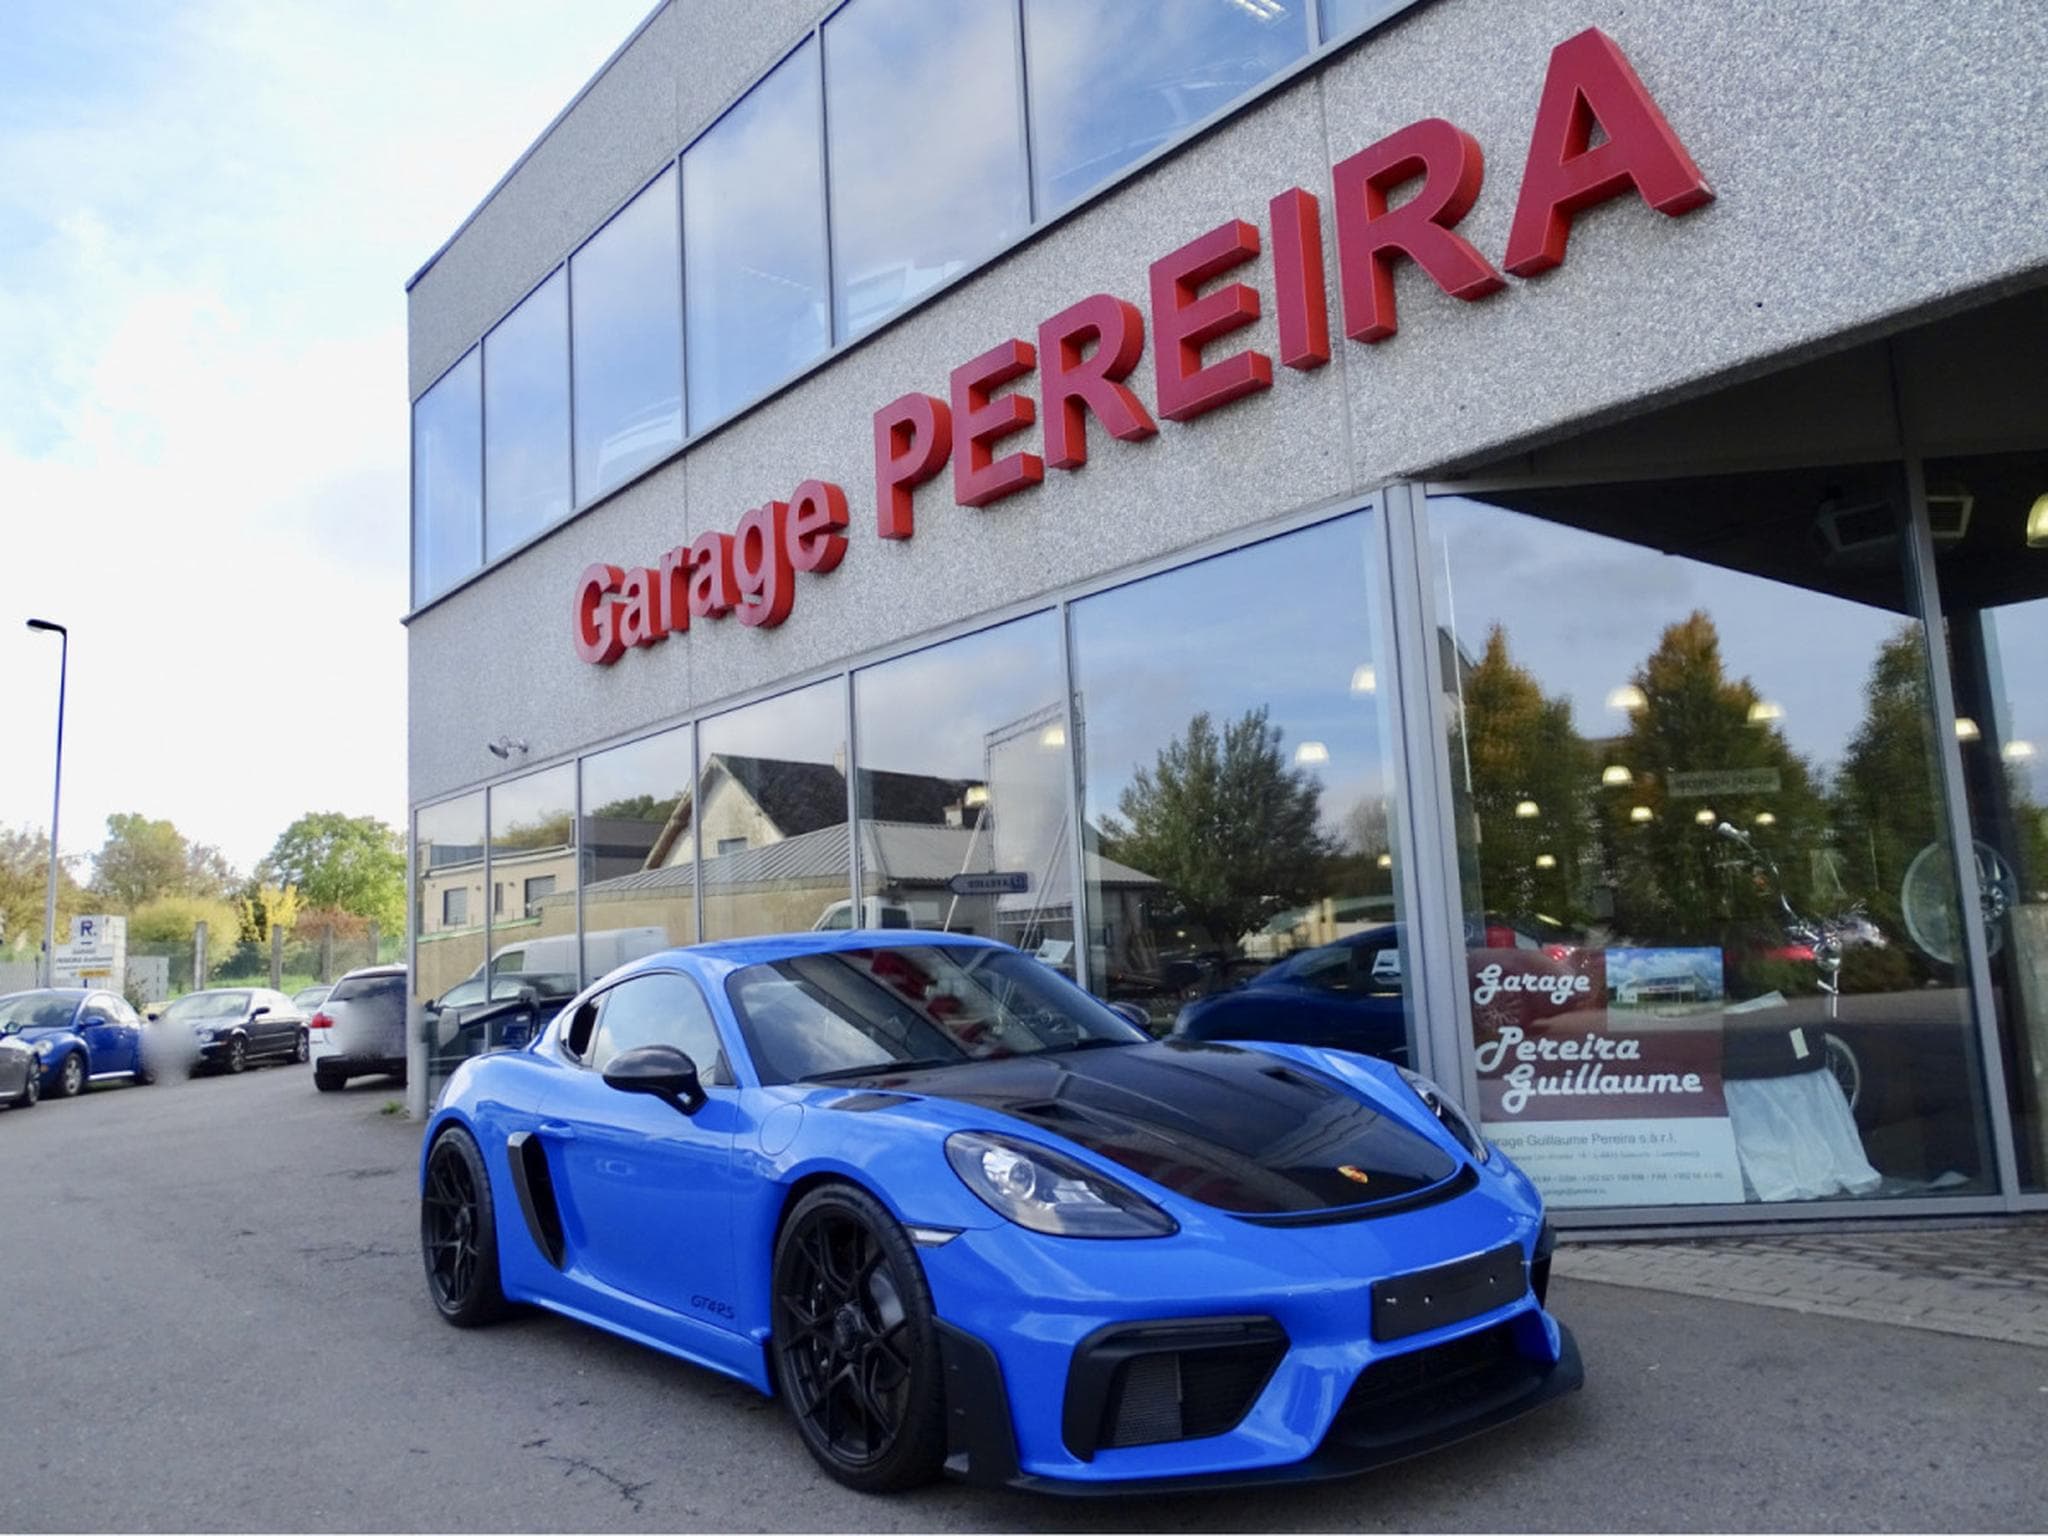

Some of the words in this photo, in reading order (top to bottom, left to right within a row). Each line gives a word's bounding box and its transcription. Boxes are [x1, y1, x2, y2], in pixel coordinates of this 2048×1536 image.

[573, 478, 849, 665] Garage
[874, 26, 1715, 540] PEREIRA
[1474, 963, 1591, 1005] Garage
[1476, 1026, 1641, 1072] Pereira
[1501, 1063, 1703, 1114] Guillaume
[1482, 1136, 1524, 1149] arage
[1526, 1133, 1588, 1146] Guillaume
[1591, 1132, 1636, 1145] Pereira
